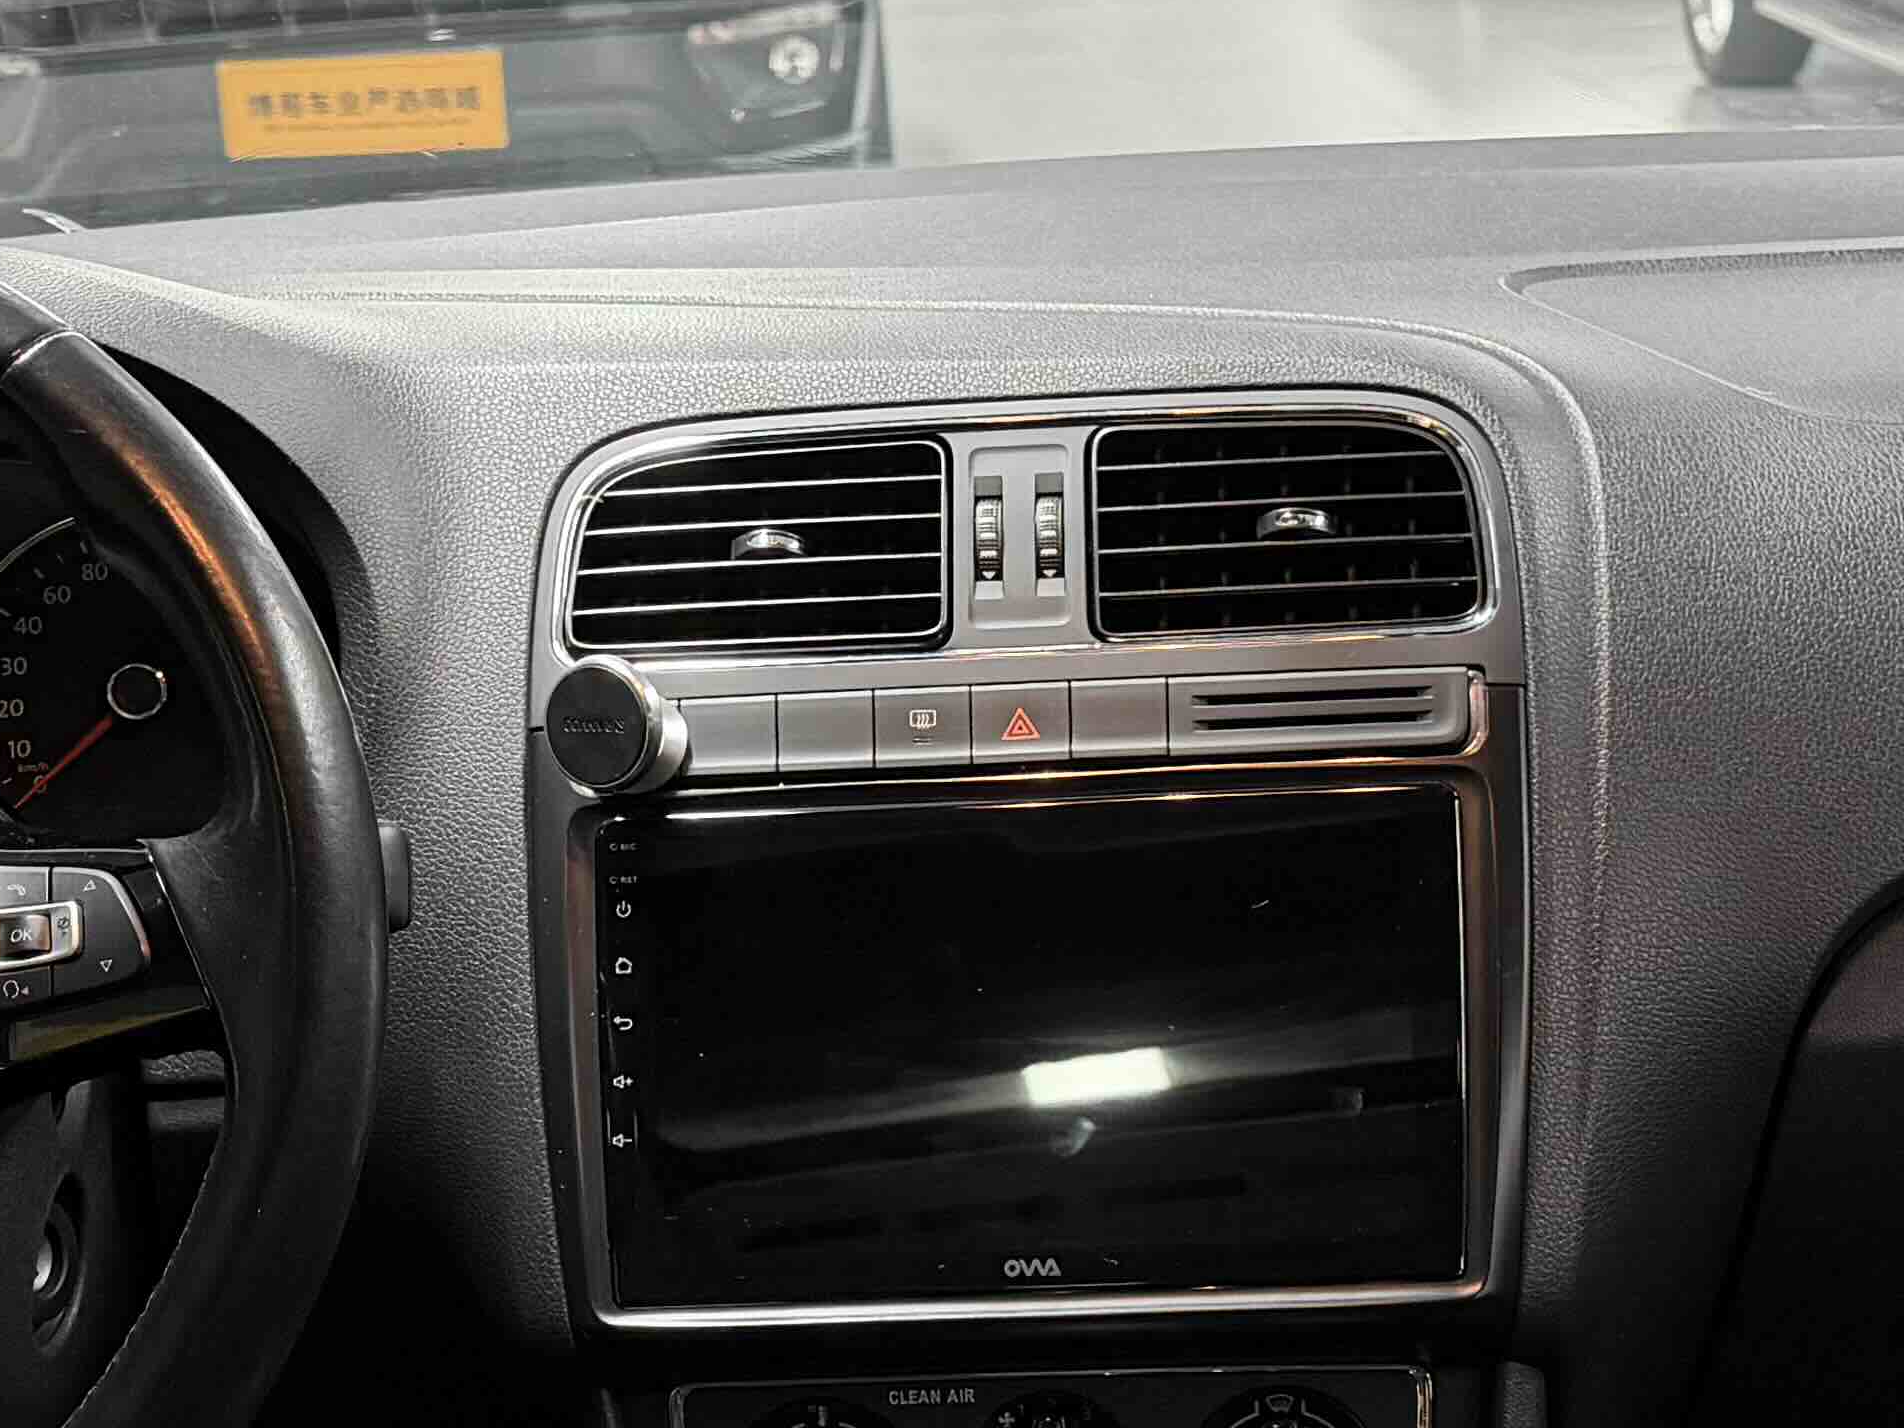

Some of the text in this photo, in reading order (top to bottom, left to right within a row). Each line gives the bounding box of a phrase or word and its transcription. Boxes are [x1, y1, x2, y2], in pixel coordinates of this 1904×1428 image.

[82, 560, 110, 582] 80
[43, 585, 72, 605] 60
[14, 614, 43, 636] 40
[0, 656, 28, 677] 30
[7, 738, 32, 760] 10
[10, 927, 33, 943] OK
[889, 1388, 976, 1406] CLEAN AIR
